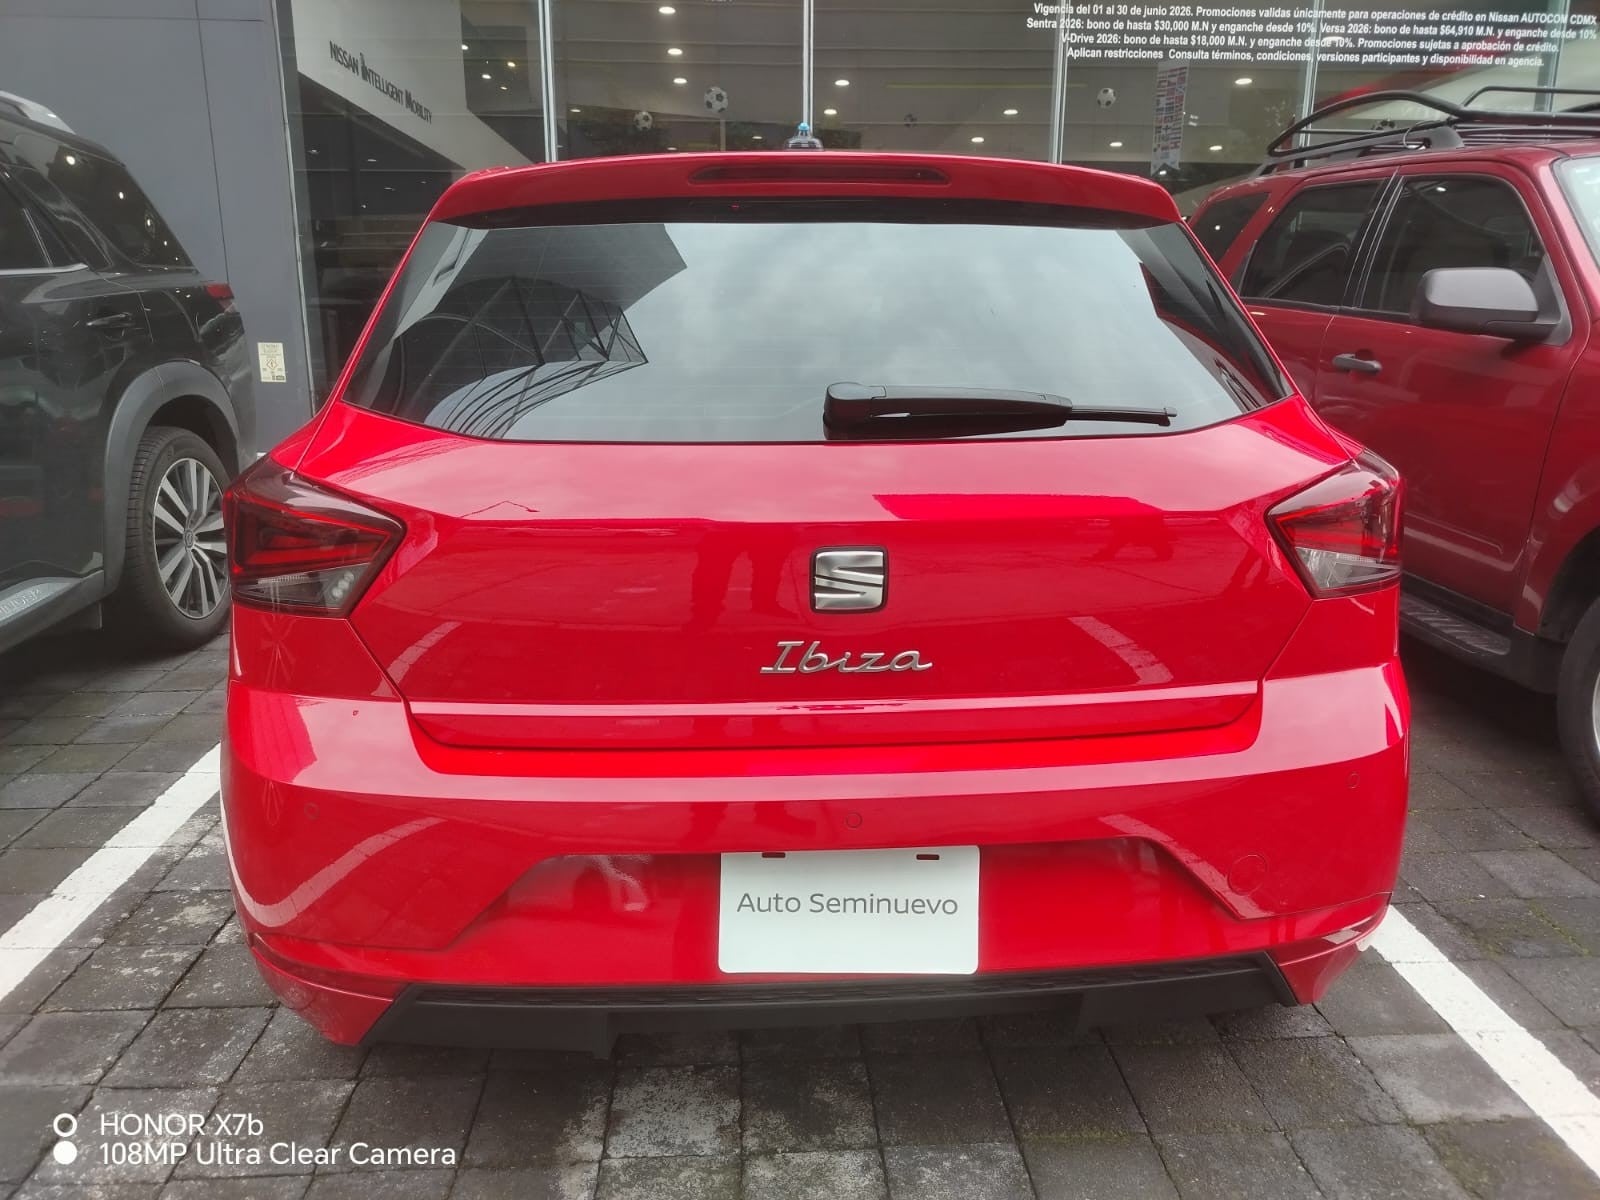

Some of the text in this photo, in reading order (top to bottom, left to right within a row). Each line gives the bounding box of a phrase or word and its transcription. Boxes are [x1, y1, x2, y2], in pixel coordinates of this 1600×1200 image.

[1034, 3, 1074, 16] Vigencia
[1076, 4, 1090, 14] del
[1093, 5, 1103, 15] 01
[1106, 5, 1114, 15] al
[1117, 5, 1127, 15] 30
[1130, 5, 1141, 16] de
[1143, 6, 1167, 18] junio
[1169, 6, 1193, 16] 2026.
[1196, 7, 1256, 18] Promociones
[1259, 8, 1291, 18] validas
[1348, 11, 1369, 21] para
[1371, 10, 1426, 21] operaciones
[1429, 10, 1440, 20] de
[1442, 11, 1473, 21] crédito
[1475, 14, 1486, 22] en
[1489, 12, 1519, 23] Nissan
[1570, 14, 1597, 25] CDMX
[1026, 17, 1057, 29] Sentra
[1060, 19, 1084, 29] 2026:
[1086, 19, 1110, 30] bono
[1113, 20, 1124, 30] de
[1127, 20, 1151, 30] hasta
[1154, 20, 1189, 32] $30,000
[1191, 21, 1209, 31] M.N
[1211, 23, 1217, 34] y
[1219, 22, 1263, 34] enganche
[1266, 22, 1294, 33] desde
[1321, 23, 1345, 34] Versa
[1347, 23, 1372, 34] 2026:
[1374, 23, 1398, 34] bono
[1400, 24, 1411, 34] de
[1413, 24, 1438, 35] hasta
[1440, 24, 1474, 37] $64,910
[1475, 26, 1495, 36] M.N.
[1497, 29, 1503, 39] y
[1505, 27, 1548, 39] enganche
[1550, 28, 1577, 39] desde
[1097, 33, 1121, 44] 2026:
[1123, 34, 1147, 44] bono
[1150, 34, 1161, 45] de
[1164, 35, 1188, 45] hasta
[1191, 35, 1225, 47] $18,000
[1227, 36, 1247, 46] M.N.
[1250, 38, 1256, 48] y
[1258, 37, 1302, 49] enganche
[1358, 38, 1417, 49] Promociones
[1420, 39, 1451, 52] sujetas
[1453, 42, 1459, 50] a
[1461, 40, 1511, 52] aprobación
[1513, 41, 1524, 51] de
[1526, 41, 1559, 52] crédito.
[329, 40, 360, 76] NISSAN
[1066, 47, 1102, 60] Aplican
[1168, 49, 1209, 59] Consulta
[1212, 50, 1254, 62] términos,
[1317, 52, 1360, 62] versiones
[1362, 53, 1420, 64] participantes
[1422, 56, 1428, 66] y
[1430, 53, 1493, 66] disponibilidad
[1495, 57, 1506, 65] en
[1508, 56, 1545, 68] agencia.
[760, 641, 933, 674] Ibiza
[737, 893, 958, 915] Auto Seminuevo
